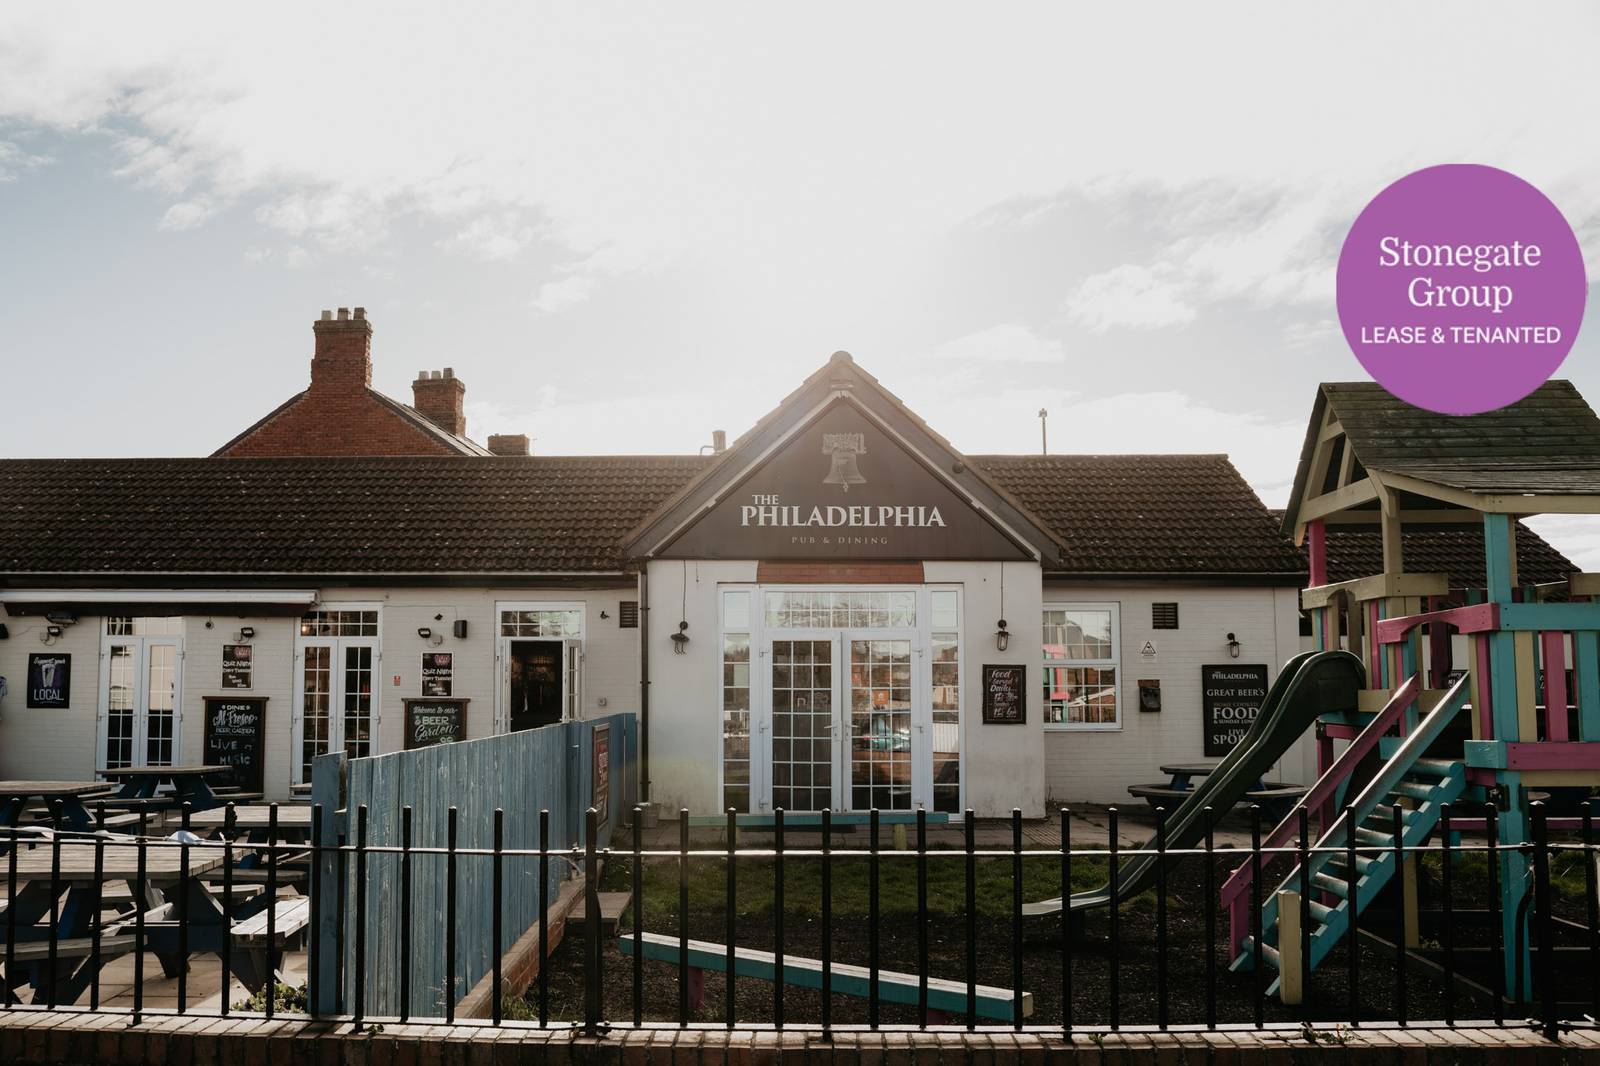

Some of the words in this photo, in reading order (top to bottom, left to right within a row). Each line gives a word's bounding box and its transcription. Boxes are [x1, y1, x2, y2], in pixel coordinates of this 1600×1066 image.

[752, 494, 780, 505] THE
[740, 505, 948, 528] PHILADELPHIA
[791, 536, 816, 545] PUB
[822, 536, 831, 545] &
[838, 536, 889, 545] DINING
[991, 669, 1011, 678] Food
[33, 688, 65, 701] LOCAL
[1206, 688, 1235, 697] GREAT
[1238, 687, 1265, 697] BEER'S
[1213, 706, 1259, 720] FOOD
[422, 716, 449, 725] BEER
[414, 724, 460, 743] Garden
[1228, 728, 1245, 736] LIVE
